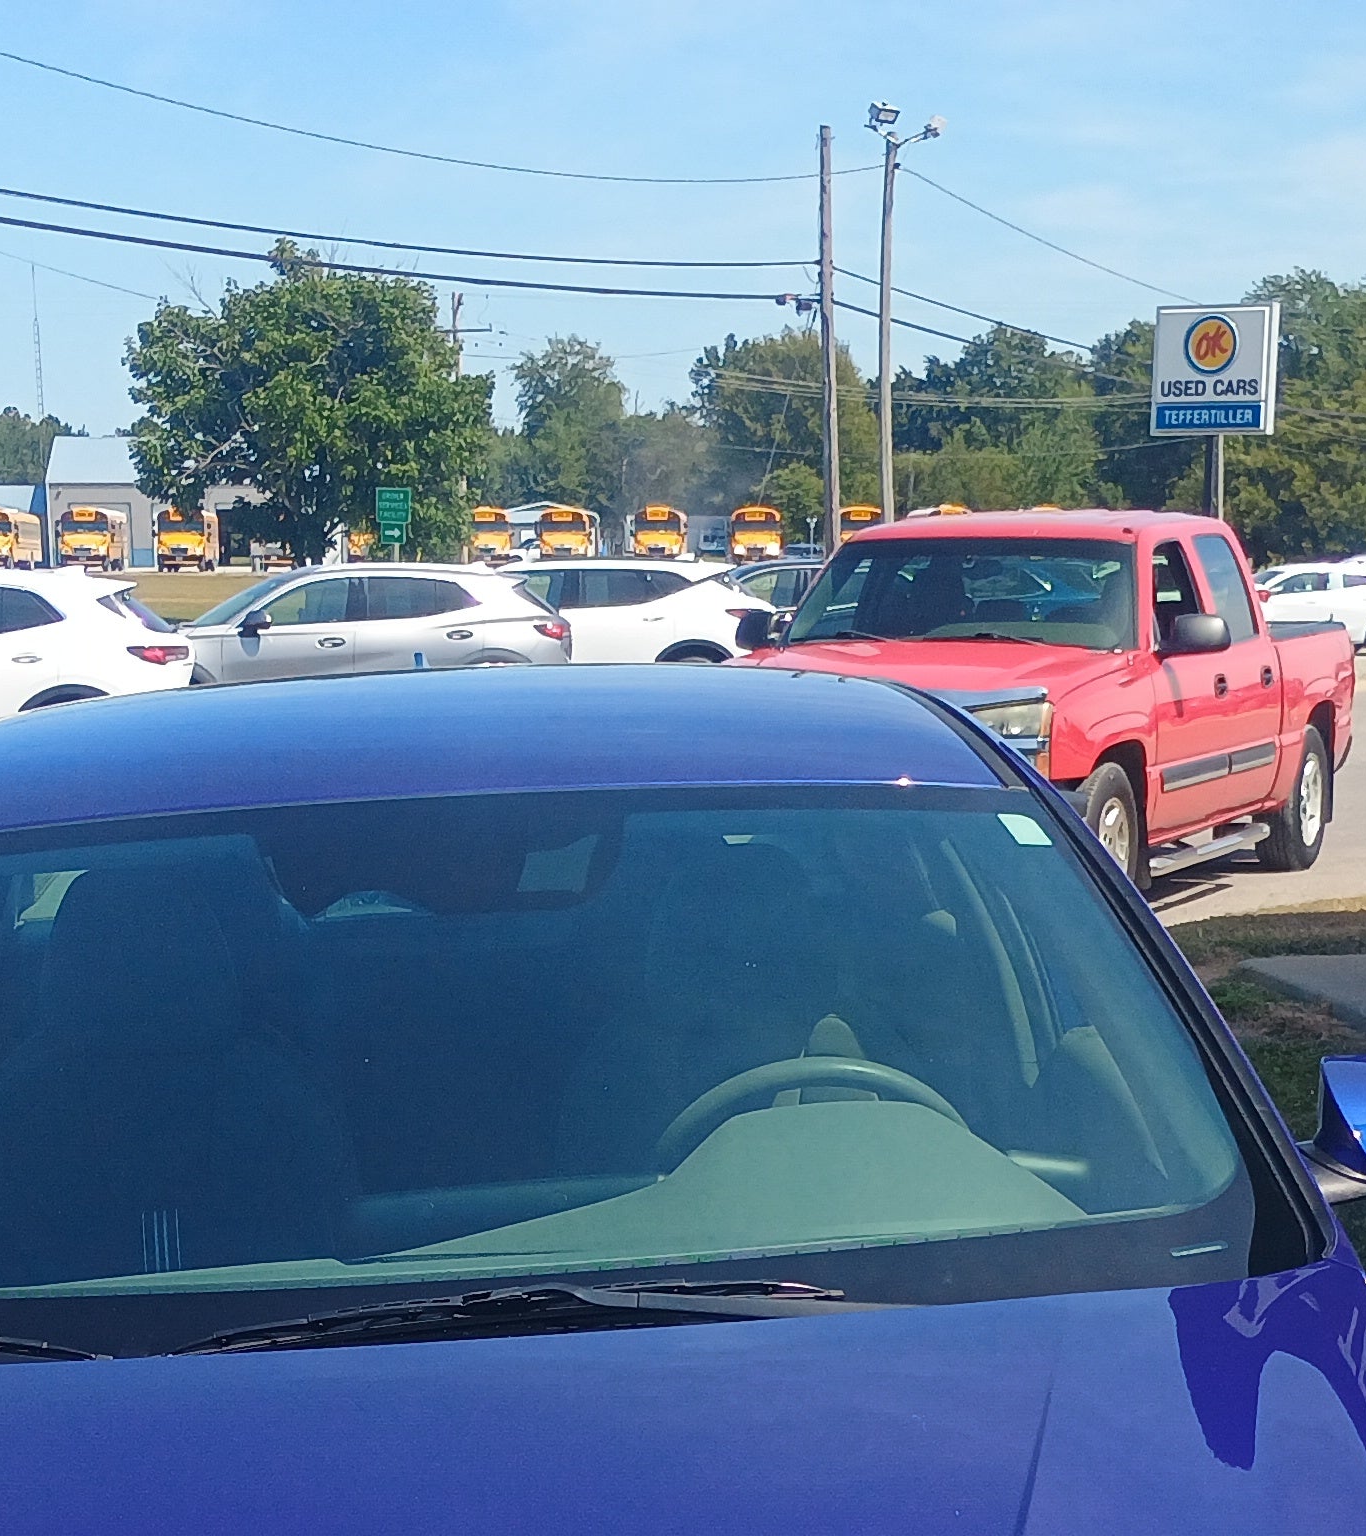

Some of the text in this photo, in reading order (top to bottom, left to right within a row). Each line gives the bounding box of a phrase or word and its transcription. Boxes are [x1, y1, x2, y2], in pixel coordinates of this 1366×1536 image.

[1195, 325, 1229, 361] OK
[1160, 379, 1259, 397] USED CARS
[1164, 409, 1253, 425] TEFFERTILLER
